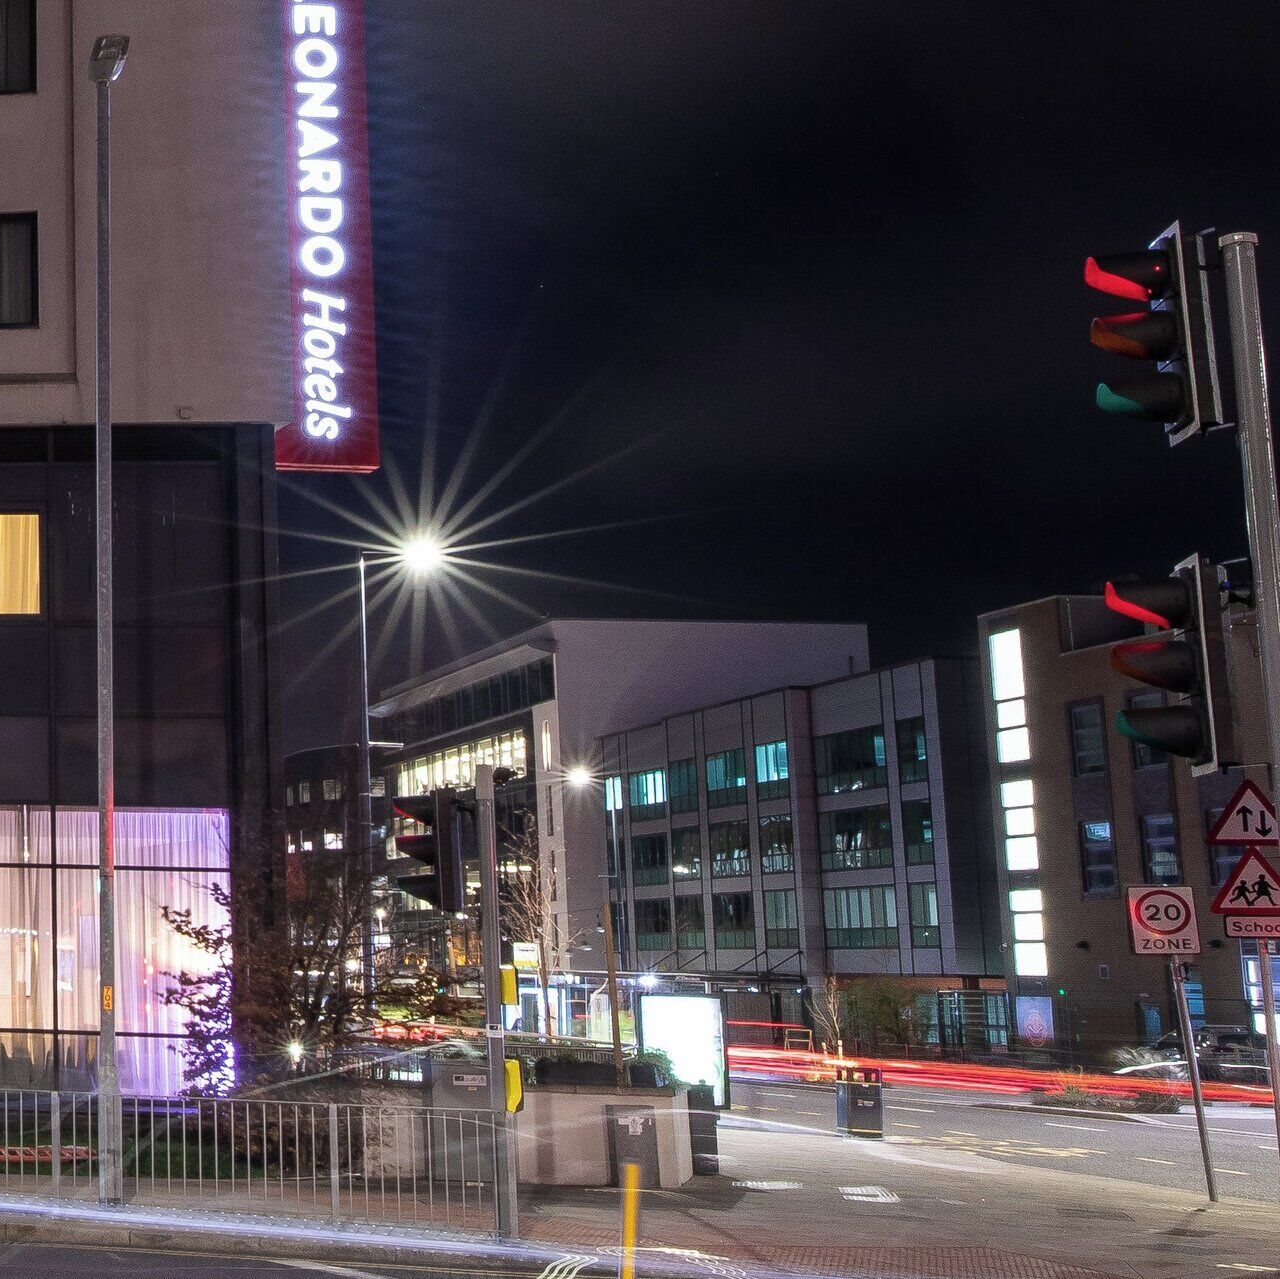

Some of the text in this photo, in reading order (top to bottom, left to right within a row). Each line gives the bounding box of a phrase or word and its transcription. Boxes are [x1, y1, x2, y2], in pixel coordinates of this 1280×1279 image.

[301, 288, 352, 441] Hotels
[1144, 903, 1182, 921] 20
[1232, 921, 1280, 933] Schoo
[1141, 938, 1194, 950] ZONE
